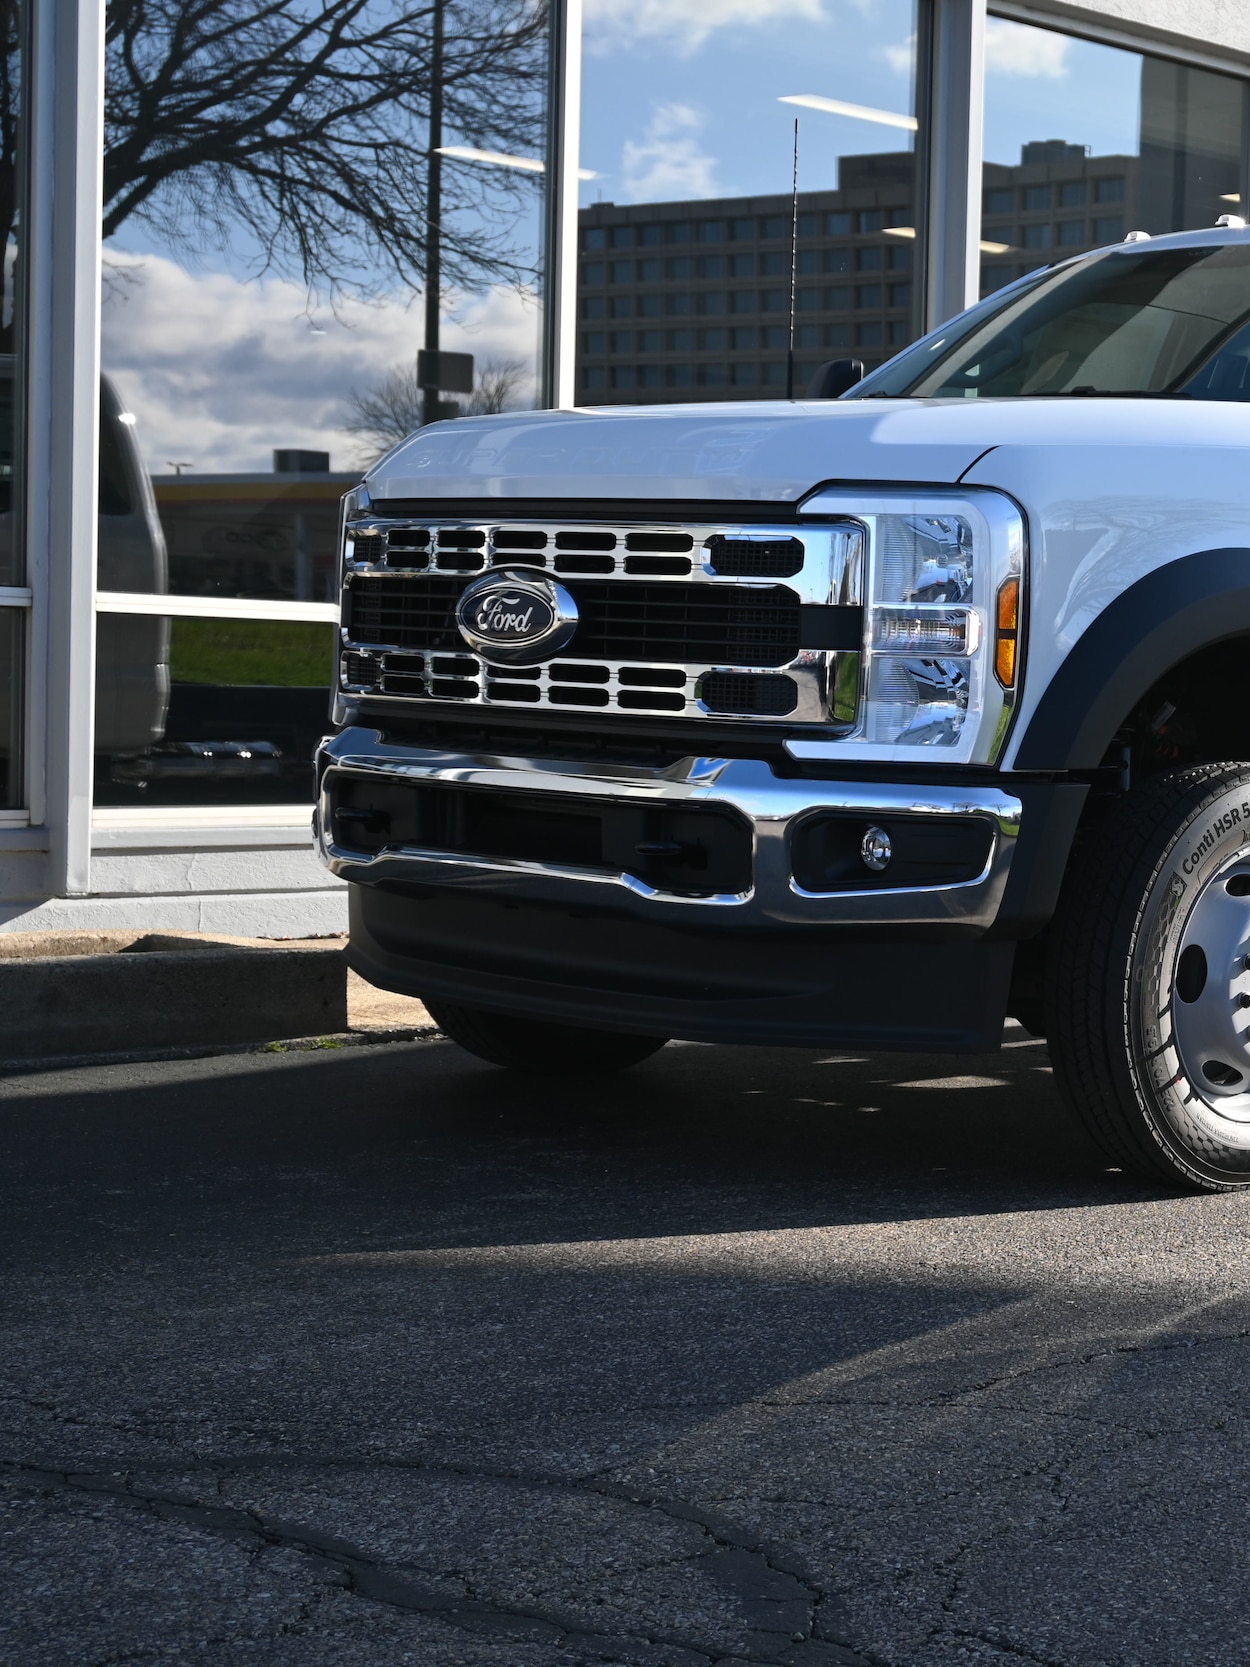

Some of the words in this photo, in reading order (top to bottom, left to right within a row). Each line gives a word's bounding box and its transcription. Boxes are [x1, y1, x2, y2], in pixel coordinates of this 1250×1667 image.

[477, 594, 534, 633] Ford
[1182, 829, 1215, 875] Conti
[1212, 808, 1242, 838] HSR
[1241, 802, 1250, 819] 5
